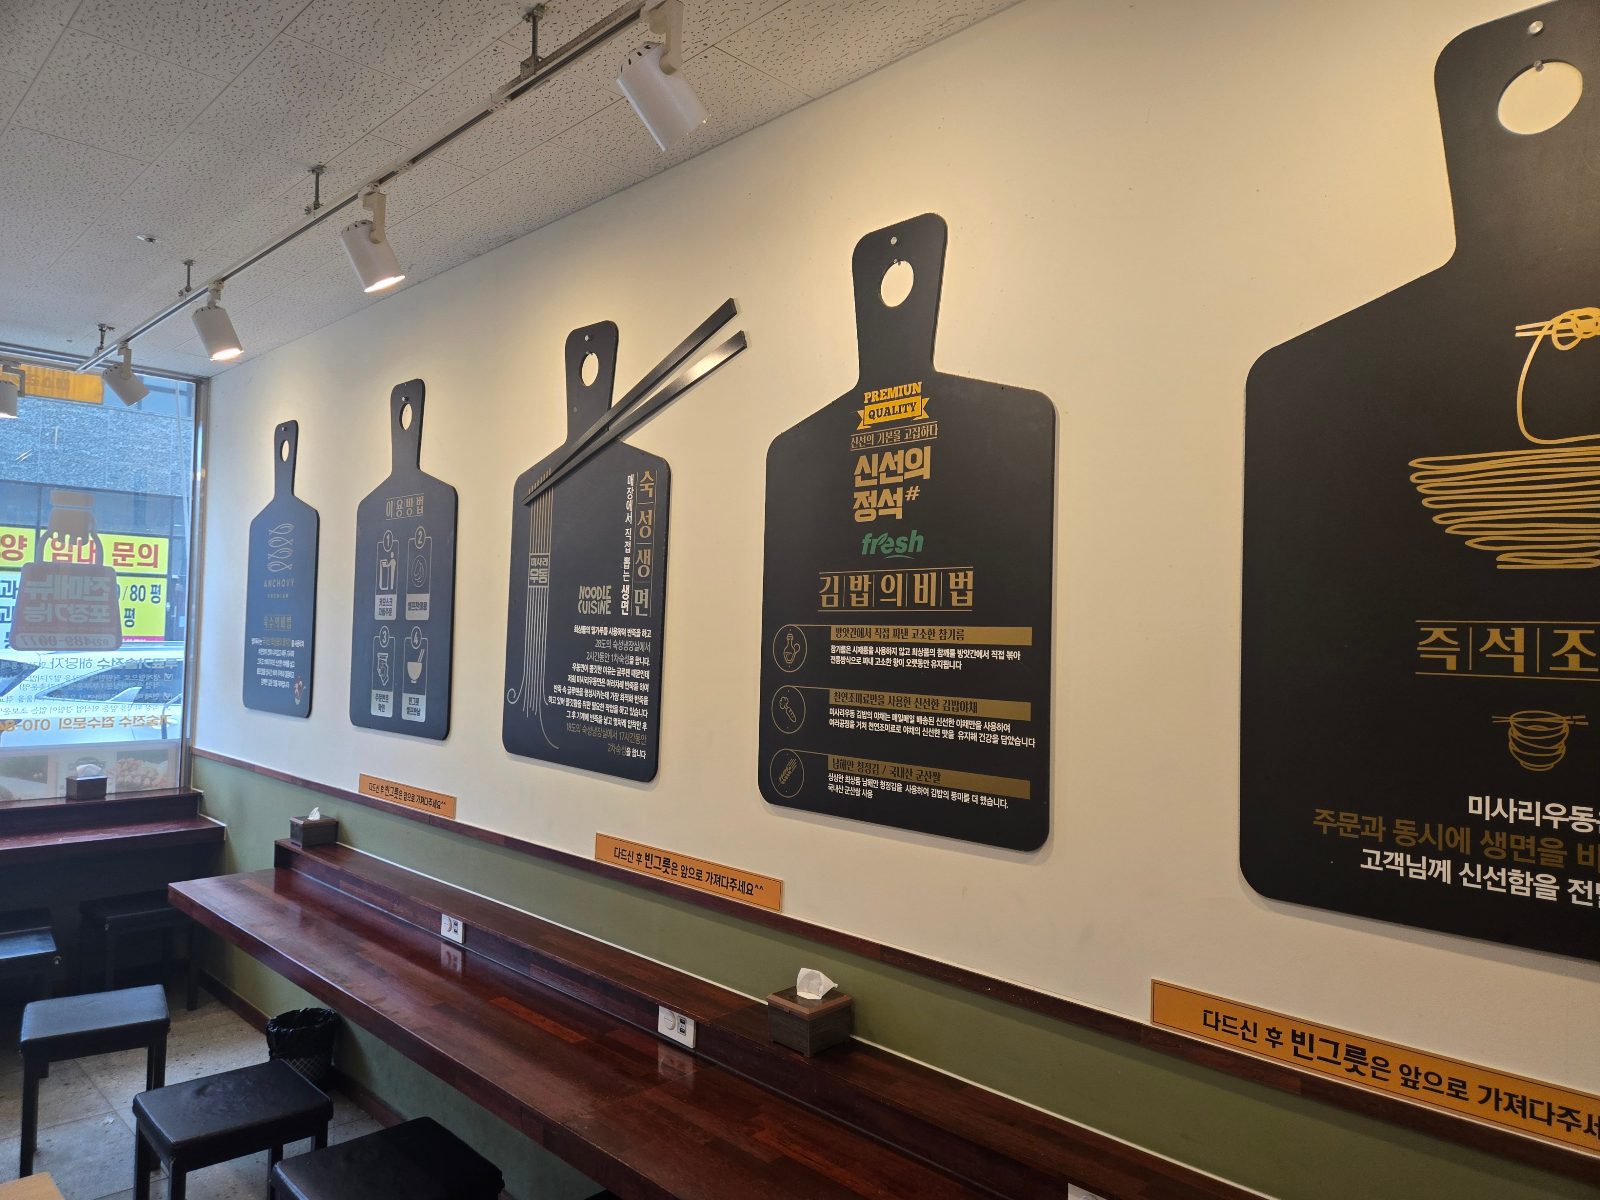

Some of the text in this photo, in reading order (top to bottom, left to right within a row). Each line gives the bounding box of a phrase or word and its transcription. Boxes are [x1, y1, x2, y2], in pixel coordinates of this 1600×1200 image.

[868, 401, 918, 420] QUALITY
[851, 423, 938, 449] 신선의 기본을 고집하다
[853, 446, 932, 488] 신선의
[624, 527, 632, 554] 직접
[861, 529, 925, 556] fresh
[112, 541, 159, 569] 문의
[529, 568, 549, 584] 우동
[578, 585, 612, 601] NOODLE
[621, 584, 630, 616] 생면
[124, 608, 136, 628] 평
[577, 599, 612, 615] CUISINE
[835, 627, 872, 639] 방앗간에서
[875, 627, 890, 639] 직접
[912, 628, 935, 641] 고소한
[938, 628, 965, 640] 참기름
[874, 657, 892, 667] 고소한
[991, 650, 1005, 661] 직접
[888, 695, 911, 708] 사용한
[914, 697, 939, 710] 신선한
[943, 700, 978, 714] 김밥야채
[829, 707, 855, 719] 미사리우동
[856, 709, 873, 720] 김밥의
[936, 716, 955, 728] 신선한
[983, 721, 1011, 734] 사용하여
[922, 727, 941, 739] 신선한
[942, 729, 955, 740] 맛을
[957, 730, 978, 743] 유지해
[979, 732, 999, 745] 건강을
[1000, 735, 1036, 748] 담았습니다
[861, 788, 874, 799] 사용
[905, 784, 930, 796] 사용하여
[930, 788, 950, 800] 김밥의
[971, 794, 979, 804] 더
[1468, 795, 1600, 836] 미사리우동
[1312, 808, 1387, 842] 주문과
[1391, 818, 1471, 855] 동시에
[1480, 829, 1568, 869] 생면을
[613, 847, 634, 864] 다드신
[635, 852, 643, 866] 후
[644, 852, 679, 876] 빈그릇은
[680, 864, 704, 882] 앞으로
[1359, 848, 1452, 884] 고객님께
[1458, 861, 1560, 902] 신선함을
[1202, 1009, 1258, 1044] 다드신
[1265, 1025, 1284, 1049] 후
[1290, 1028, 1392, 1082] 빈그릇은
[1398, 1062, 1470, 1102] 앞으로
